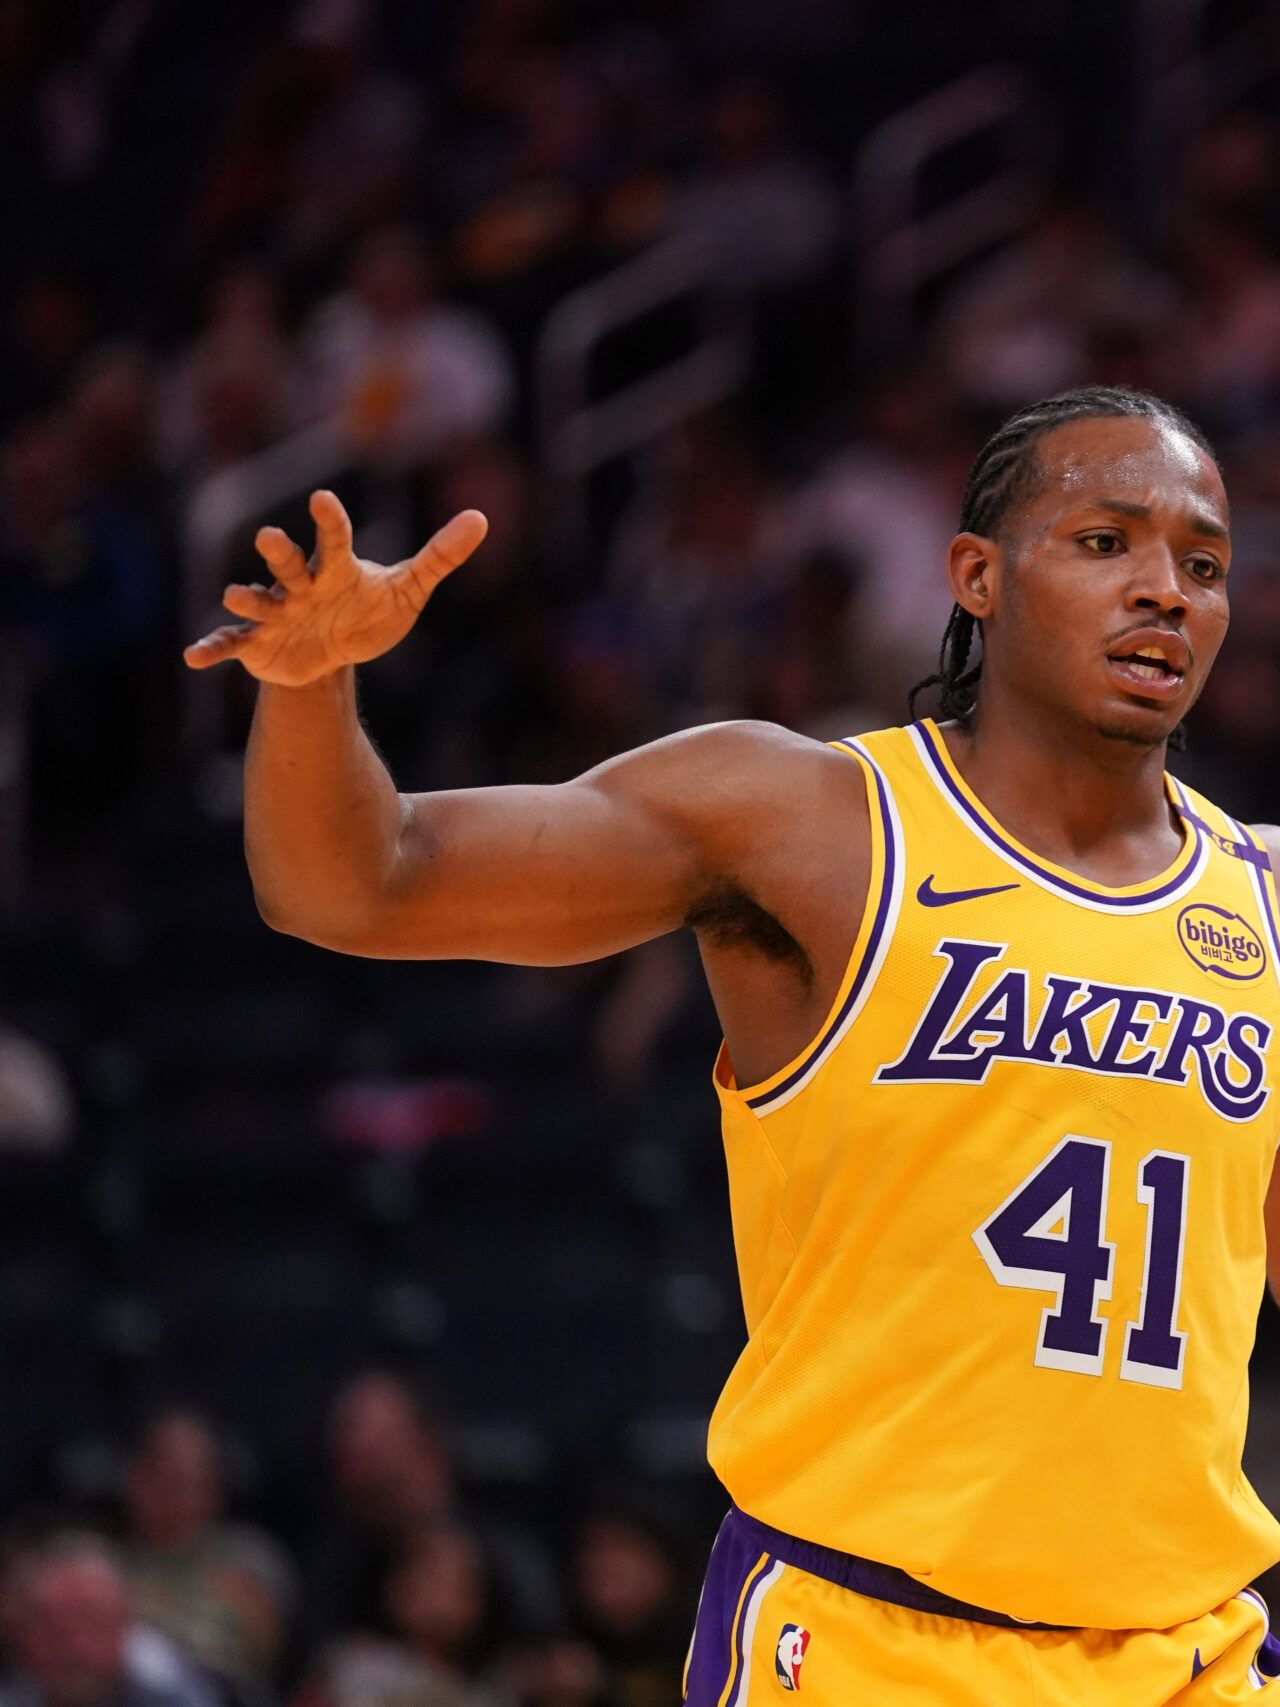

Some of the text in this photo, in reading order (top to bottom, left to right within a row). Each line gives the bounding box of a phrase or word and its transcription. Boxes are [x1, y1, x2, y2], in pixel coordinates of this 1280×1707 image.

[1185, 917, 1260, 962] bibigo
[1200, 945, 1234, 963] 비비고
[872, 938, 1273, 1121] LAKERS
[970, 1133, 1191, 1391] 41
